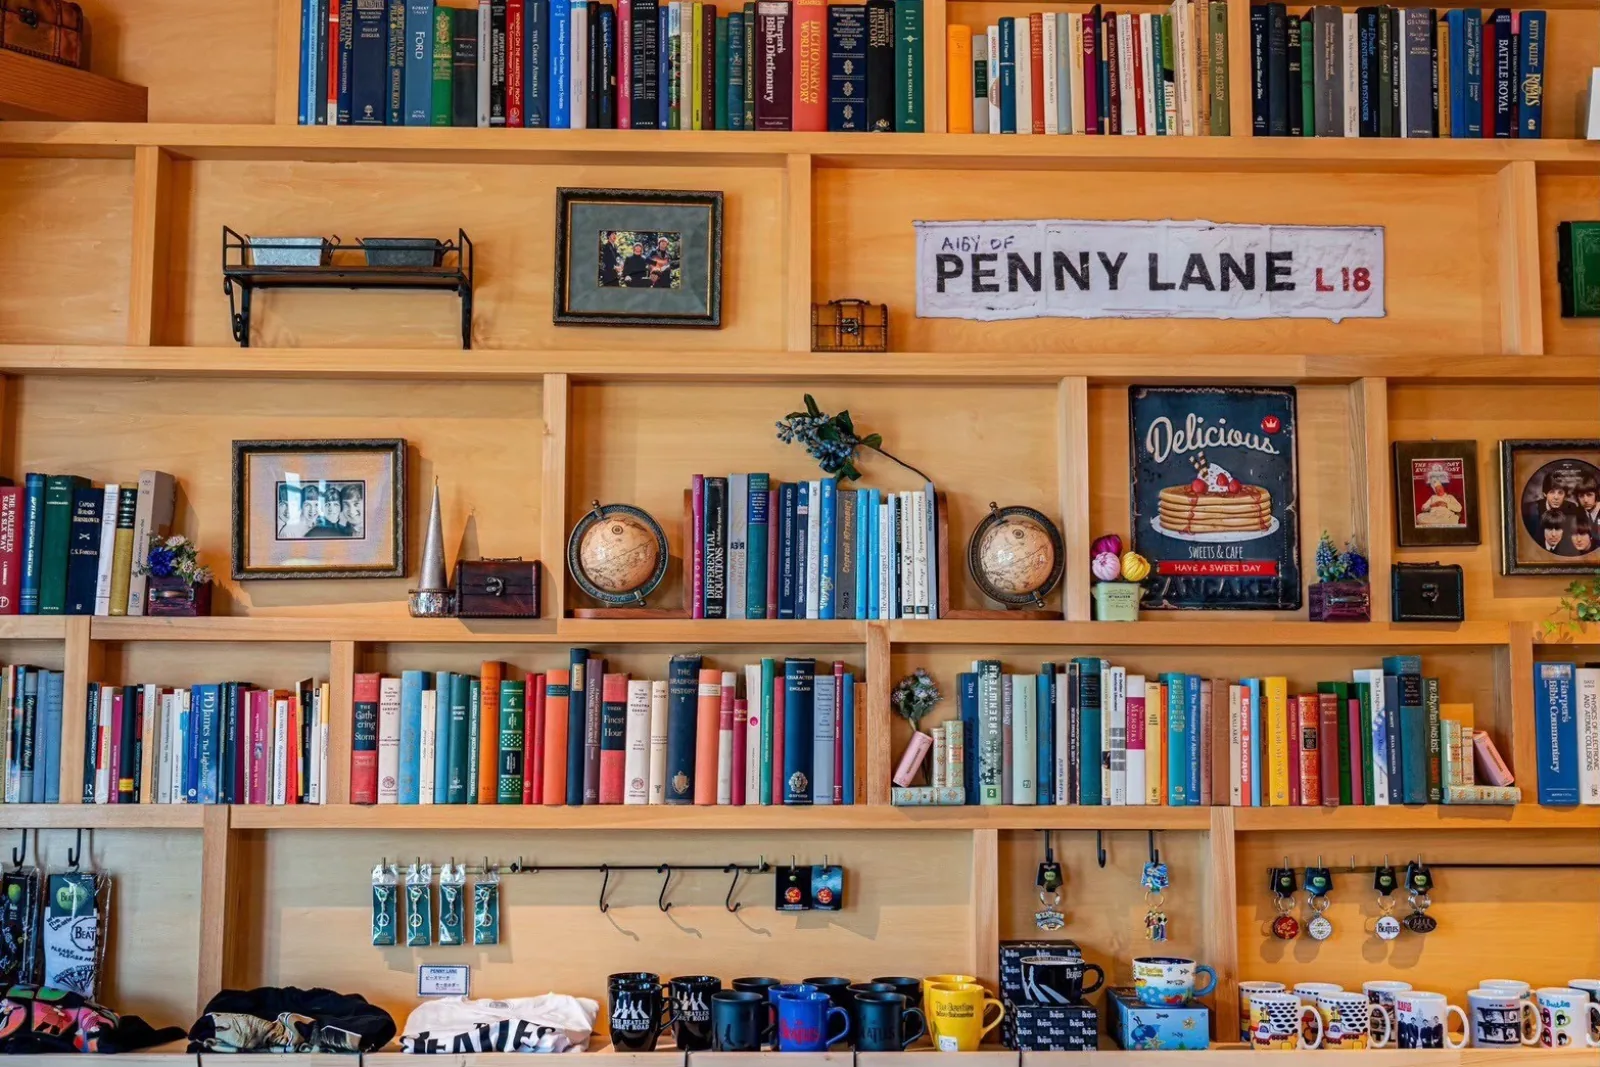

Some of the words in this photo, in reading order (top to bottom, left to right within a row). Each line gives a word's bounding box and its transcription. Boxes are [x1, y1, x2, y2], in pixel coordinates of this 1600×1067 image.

[764, 16, 775, 45] Bible
[776, 16, 786, 53] Harper's
[869, 7, 878, 48] HISTORY
[1368, 14, 1376, 27] Peter
[1467, 17, 1475, 39] House
[1529, 20, 1539, 41] KITTY
[415, 31, 425, 60] FORD
[800, 21, 809, 58] WORLD
[1215, 32, 1224, 64] LANGUAGE
[1361, 28, 1369, 70] ADVENTURES
[1368, 32, 1376, 56] Drucker
[646, 59, 656, 75] GUIDE
[810, 20, 821, 90] DICTIONARY
[1467, 48, 1475, 76] Windsor
[1499, 39, 1509, 79] BATTLE
[1529, 42, 1539, 67] KELLEY
[764, 44, 775, 103] Dictionary
[800, 59, 809, 104] HISTORY
[1215, 66, 1224, 74] OF
[633, 83, 644, 100] NOVEL
[1109, 74, 1117, 97] WOMEN
[1215, 75, 1225, 101] ASPECTS
[1499, 80, 1509, 114] ROYAL
[1523, 73, 1541, 106] ROYALS
[1361, 84, 1369, 121] BYSTANDER
[935, 250, 1129, 293] PENNY
[1148, 249, 1297, 293] LANE
[1315, 266, 1372, 293] L18
[1145, 412, 1280, 464] Delicious
[8, 494, 16, 508] THE
[6, 510, 15, 553] ROLLEIFLEX
[27, 549, 35, 577] СВЕТИЛА
[706, 530, 716, 600] DIFFERENTIAL
[1188, 545, 1215, 560] SWEETS
[1217, 545, 1224, 560] &
[1225, 545, 1243, 560] CAFE
[715, 547, 723, 600] EQUATIONS
[1174, 563, 1199, 573] HAVE
[1200, 563, 1208, 573] A
[1209, 563, 1240, 573] SWEET
[1242, 564, 1262, 573] DAY
[677, 668, 691, 676] THE
[587, 678, 595, 709] NATHANIEL
[670, 687, 696, 695] HISTORY
[987, 664, 998, 736] ЭЙЗЕНШТЕЙН
[1190, 693, 1198, 704] The
[1548, 680, 1559, 705] Bible
[1559, 680, 1572, 723] Harper's
[355, 710, 376, 722] Gath-
[603, 715, 624, 724] Finest
[1003, 703, 1012, 726] Trilogy
[1189, 705, 1197, 735] Philosophy
[1241, 698, 1250, 731] Борис
[1590, 693, 1598, 720] PHYSICS
[201, 708, 215, 737] James
[354, 732, 376, 741] Storm
[587, 709, 595, 744] HAWTHORNE
[604, 728, 623, 738] Hour
[1591, 721, 1598, 730] OF
[1190, 742, 1198, 760] Albert
[1549, 705, 1561, 773] Commentary
[1591, 732, 1600, 771] ELECTRONIC
[201, 751, 210, 790] Lighthouse
[1240, 734, 1250, 782] Заходер
[1190, 761, 1198, 792] Schweitzer
[988, 789, 995, 797] 2
[1377, 923, 1399, 935] BEATLES
[1066, 967, 1083, 979] BEATLES
[632, 1023, 650, 1031] ROAD
